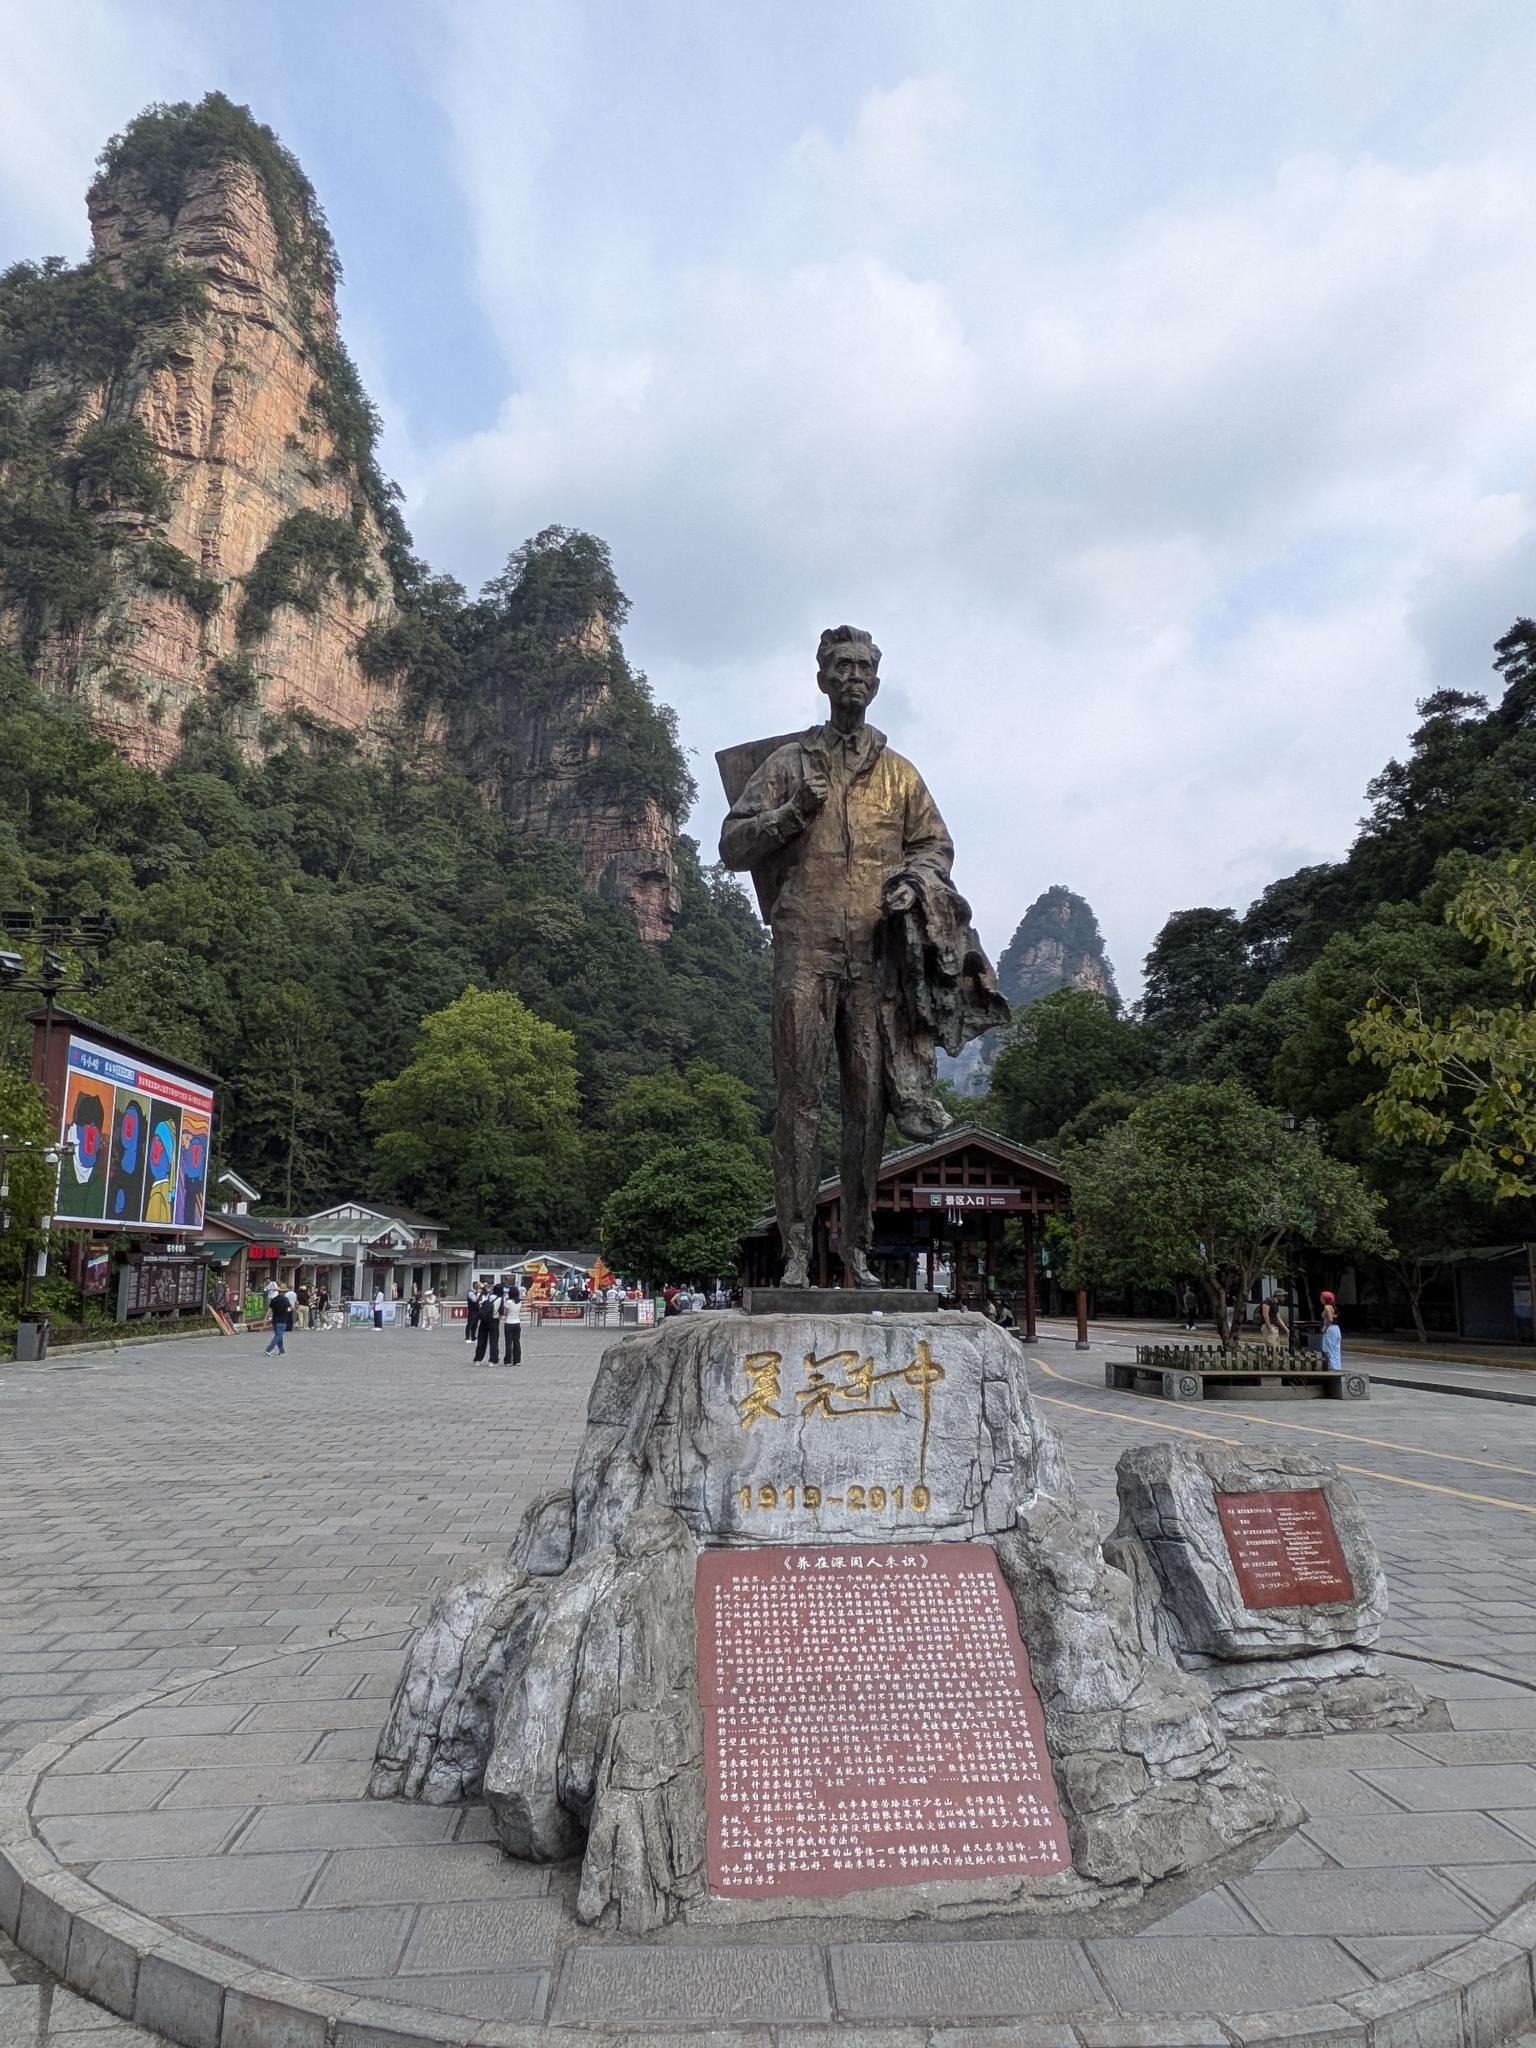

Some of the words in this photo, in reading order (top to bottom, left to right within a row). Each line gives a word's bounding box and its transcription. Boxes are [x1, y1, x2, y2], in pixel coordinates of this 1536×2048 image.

[945, 1195, 985, 1206] 景区入口
[737, 1339, 946, 1484] 吴冠中
[738, 1483, 932, 1513] 1919-2010
